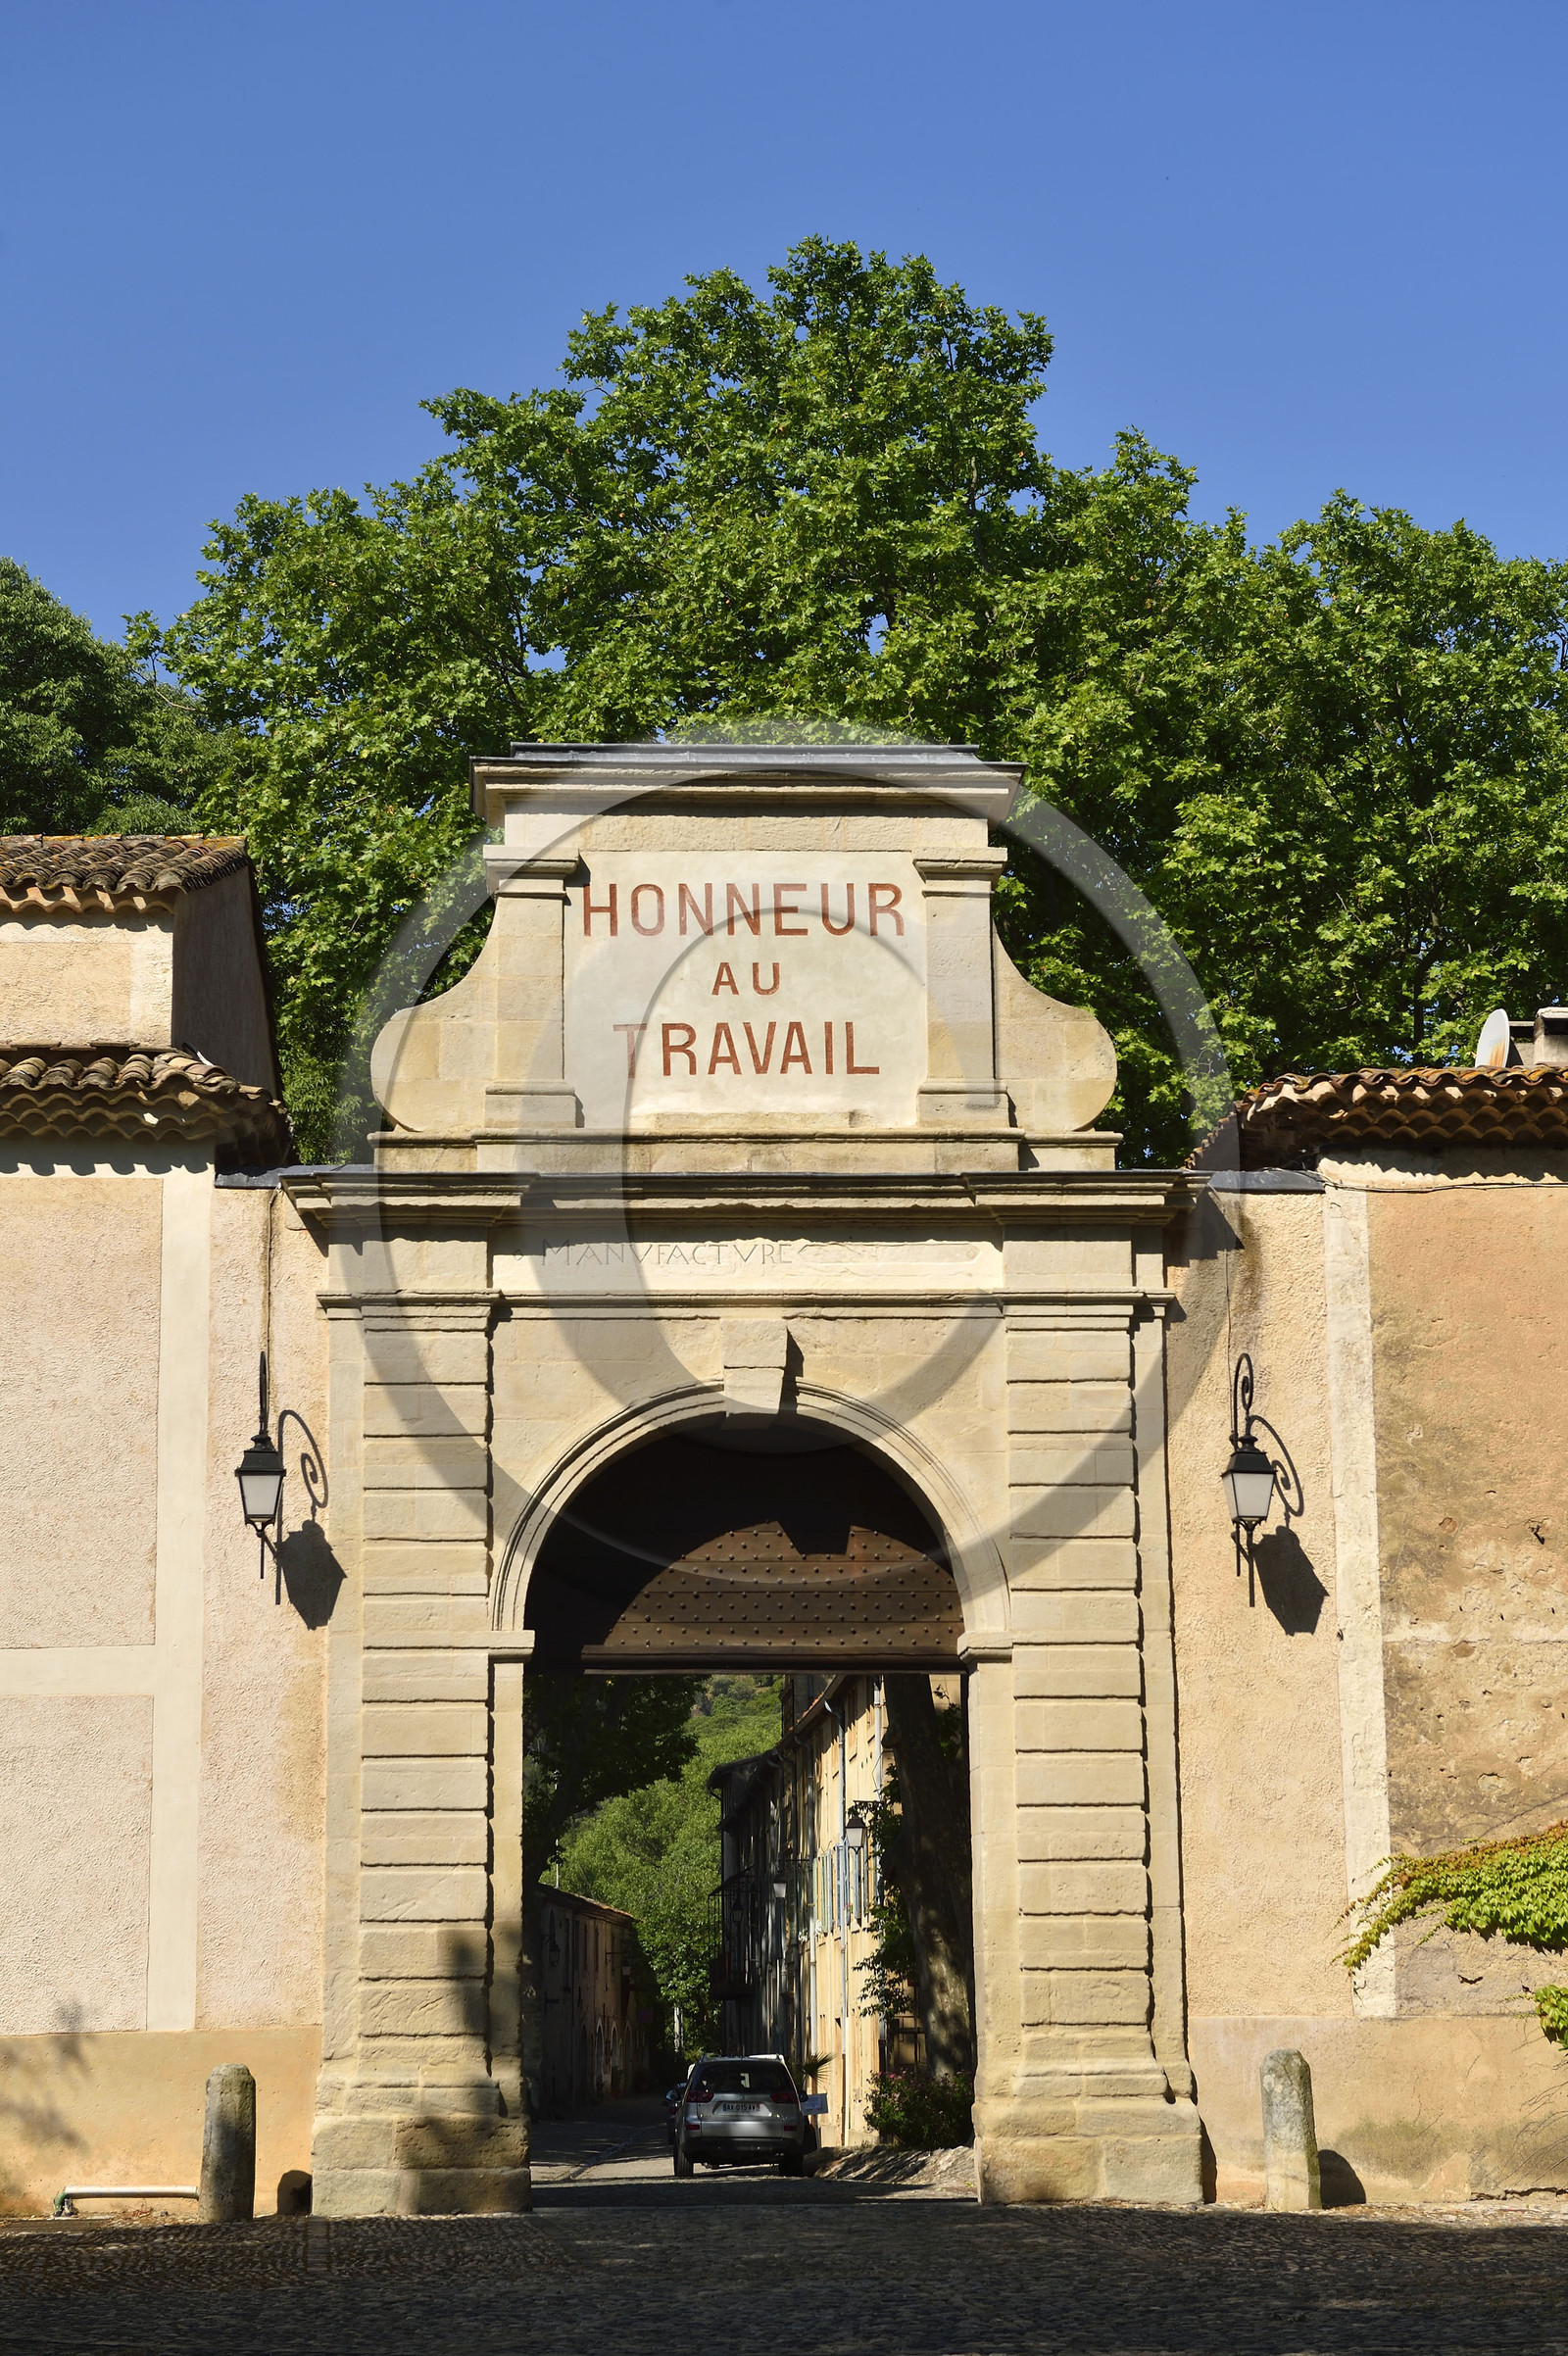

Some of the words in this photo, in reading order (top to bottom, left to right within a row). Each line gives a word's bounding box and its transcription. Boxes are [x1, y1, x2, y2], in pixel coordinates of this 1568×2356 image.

[582, 882, 906, 937] HONNEUR
[711, 961, 781, 996] AU
[612, 1021, 881, 1079] TRAVAIL
